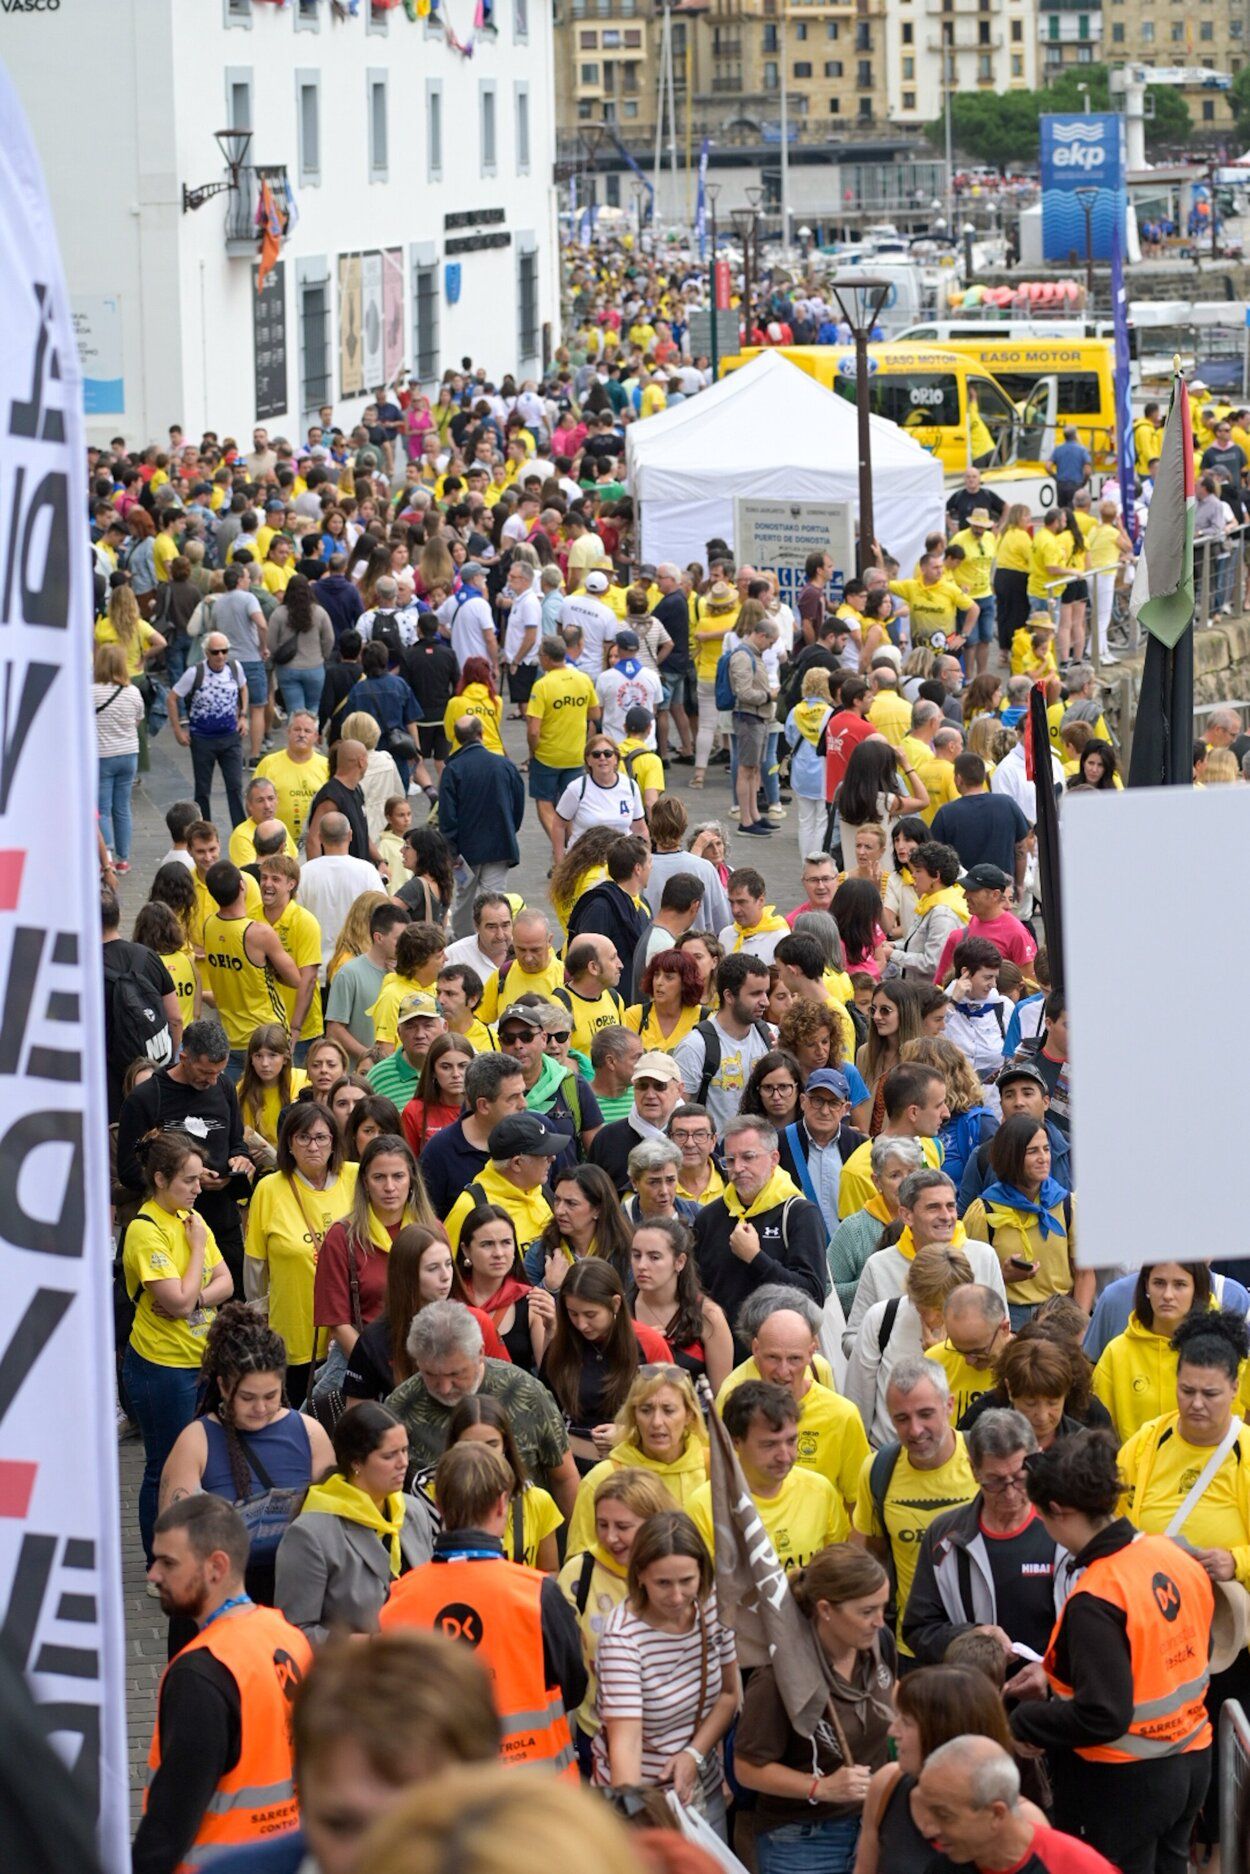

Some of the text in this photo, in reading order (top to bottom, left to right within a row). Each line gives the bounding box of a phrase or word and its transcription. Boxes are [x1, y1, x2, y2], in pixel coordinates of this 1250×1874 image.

[1, 0, 61, 12] VASCO
[1052, 141, 1105, 171] ekp
[885, 355, 957, 365] EASO MOTOR
[981, 351, 1081, 362] EASO MOTOR
[754, 522, 830, 533] DONOSTIAKO PORTUA
[754, 534, 831, 545] PUERTO DE DONOSTIA
